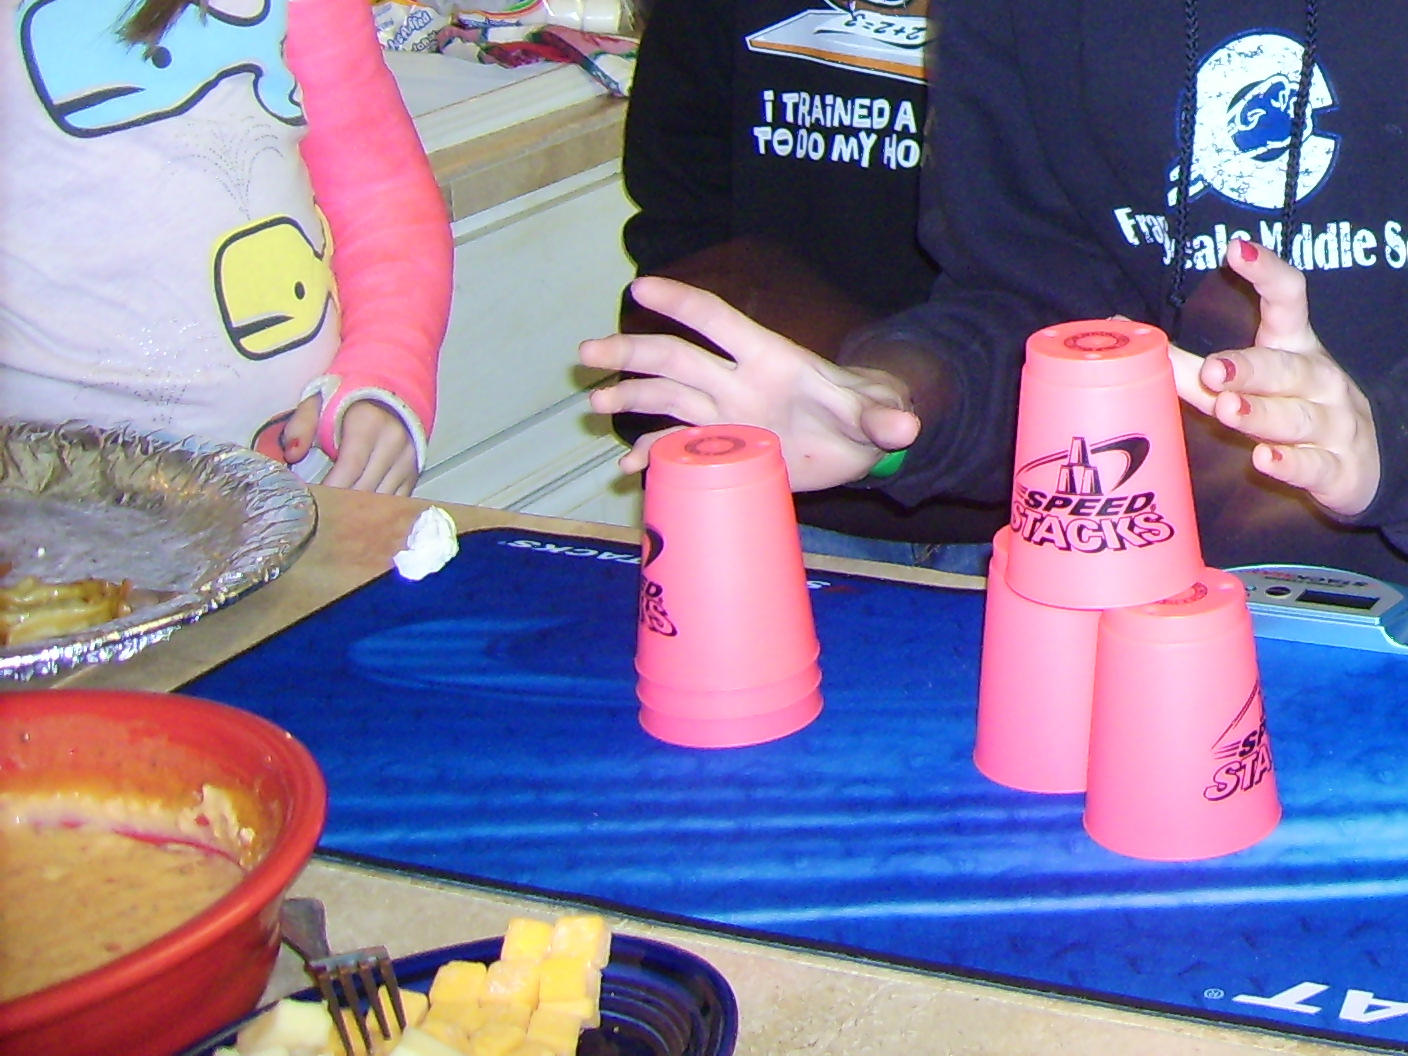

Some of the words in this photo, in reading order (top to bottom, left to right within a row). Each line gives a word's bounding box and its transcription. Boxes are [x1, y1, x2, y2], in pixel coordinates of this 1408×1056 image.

[893, 100, 918, 134] A
[752, 125, 794, 157] TO
[796, 128, 826, 162] DO
[830, 130, 878, 169] MY
[1258, 218, 1378, 271] Mddle
[1024, 490, 1157, 518] SPEED
[1010, 500, 1176, 554] STACKS
